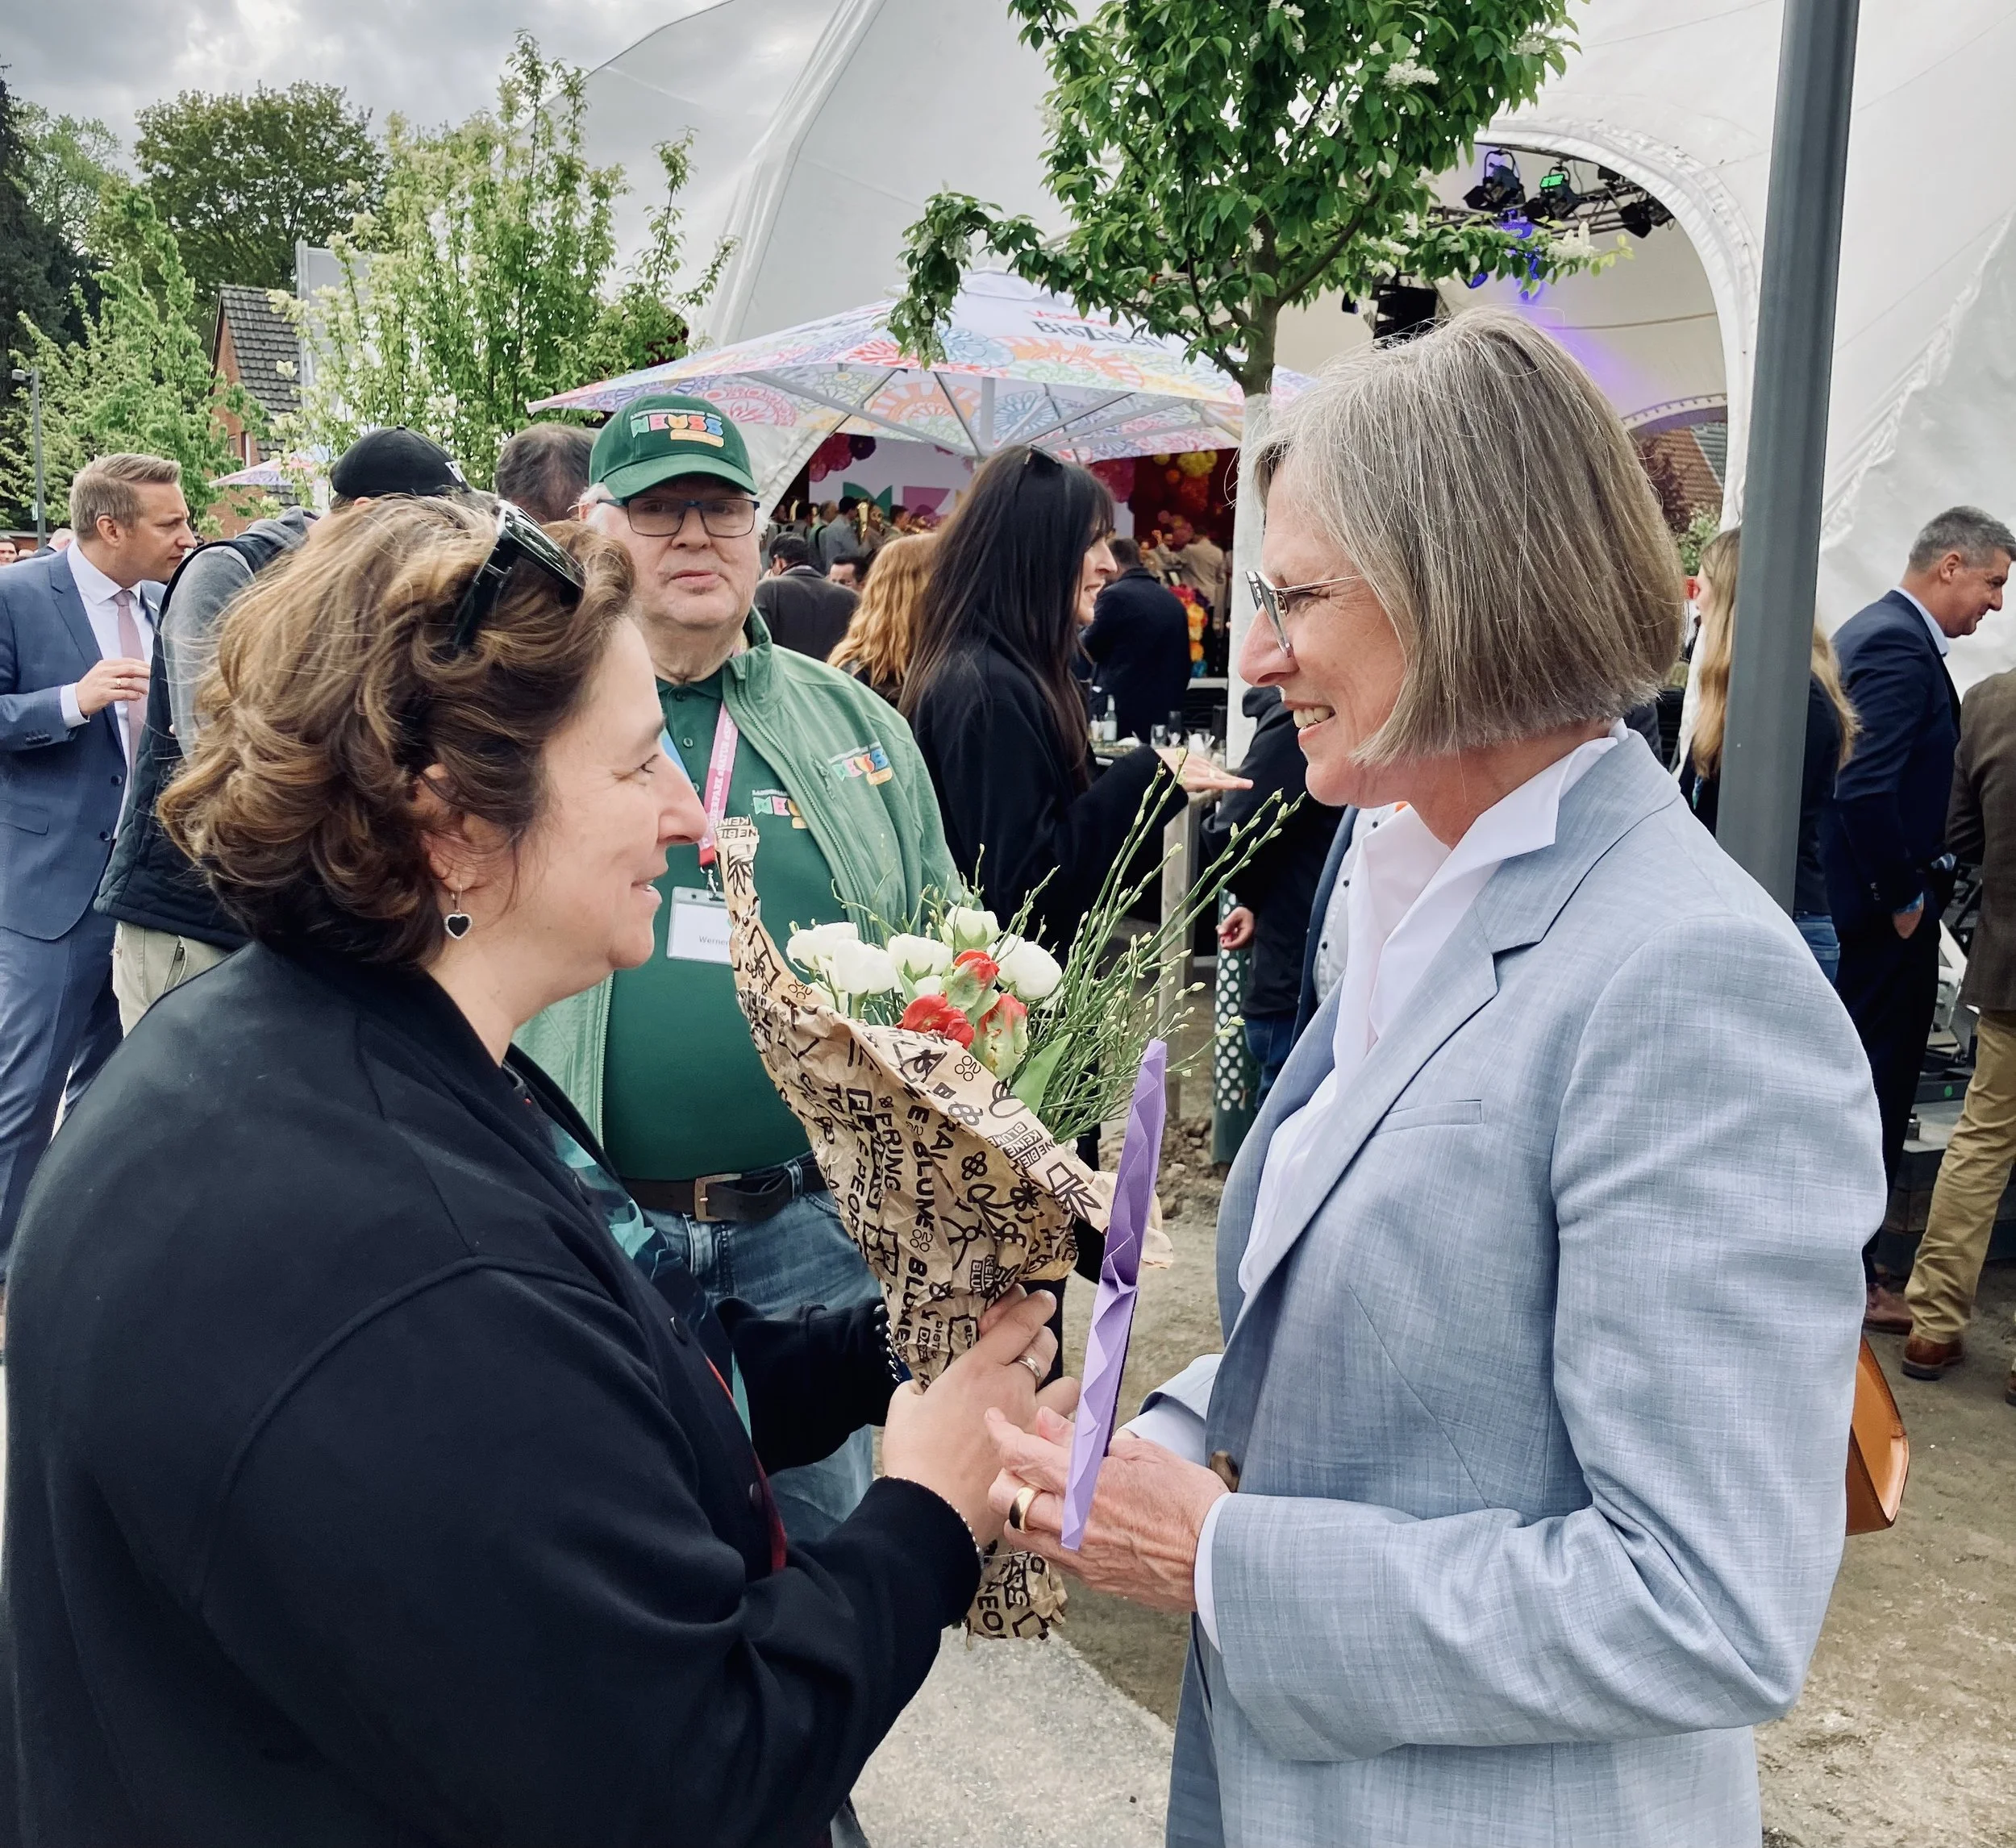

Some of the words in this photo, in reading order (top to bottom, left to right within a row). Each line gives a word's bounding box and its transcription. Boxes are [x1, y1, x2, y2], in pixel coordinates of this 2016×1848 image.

[630, 413, 724, 439] NEUSS
[1005, 1130, 1042, 1156] KEINE
[912, 1140, 936, 1232] BLUME
